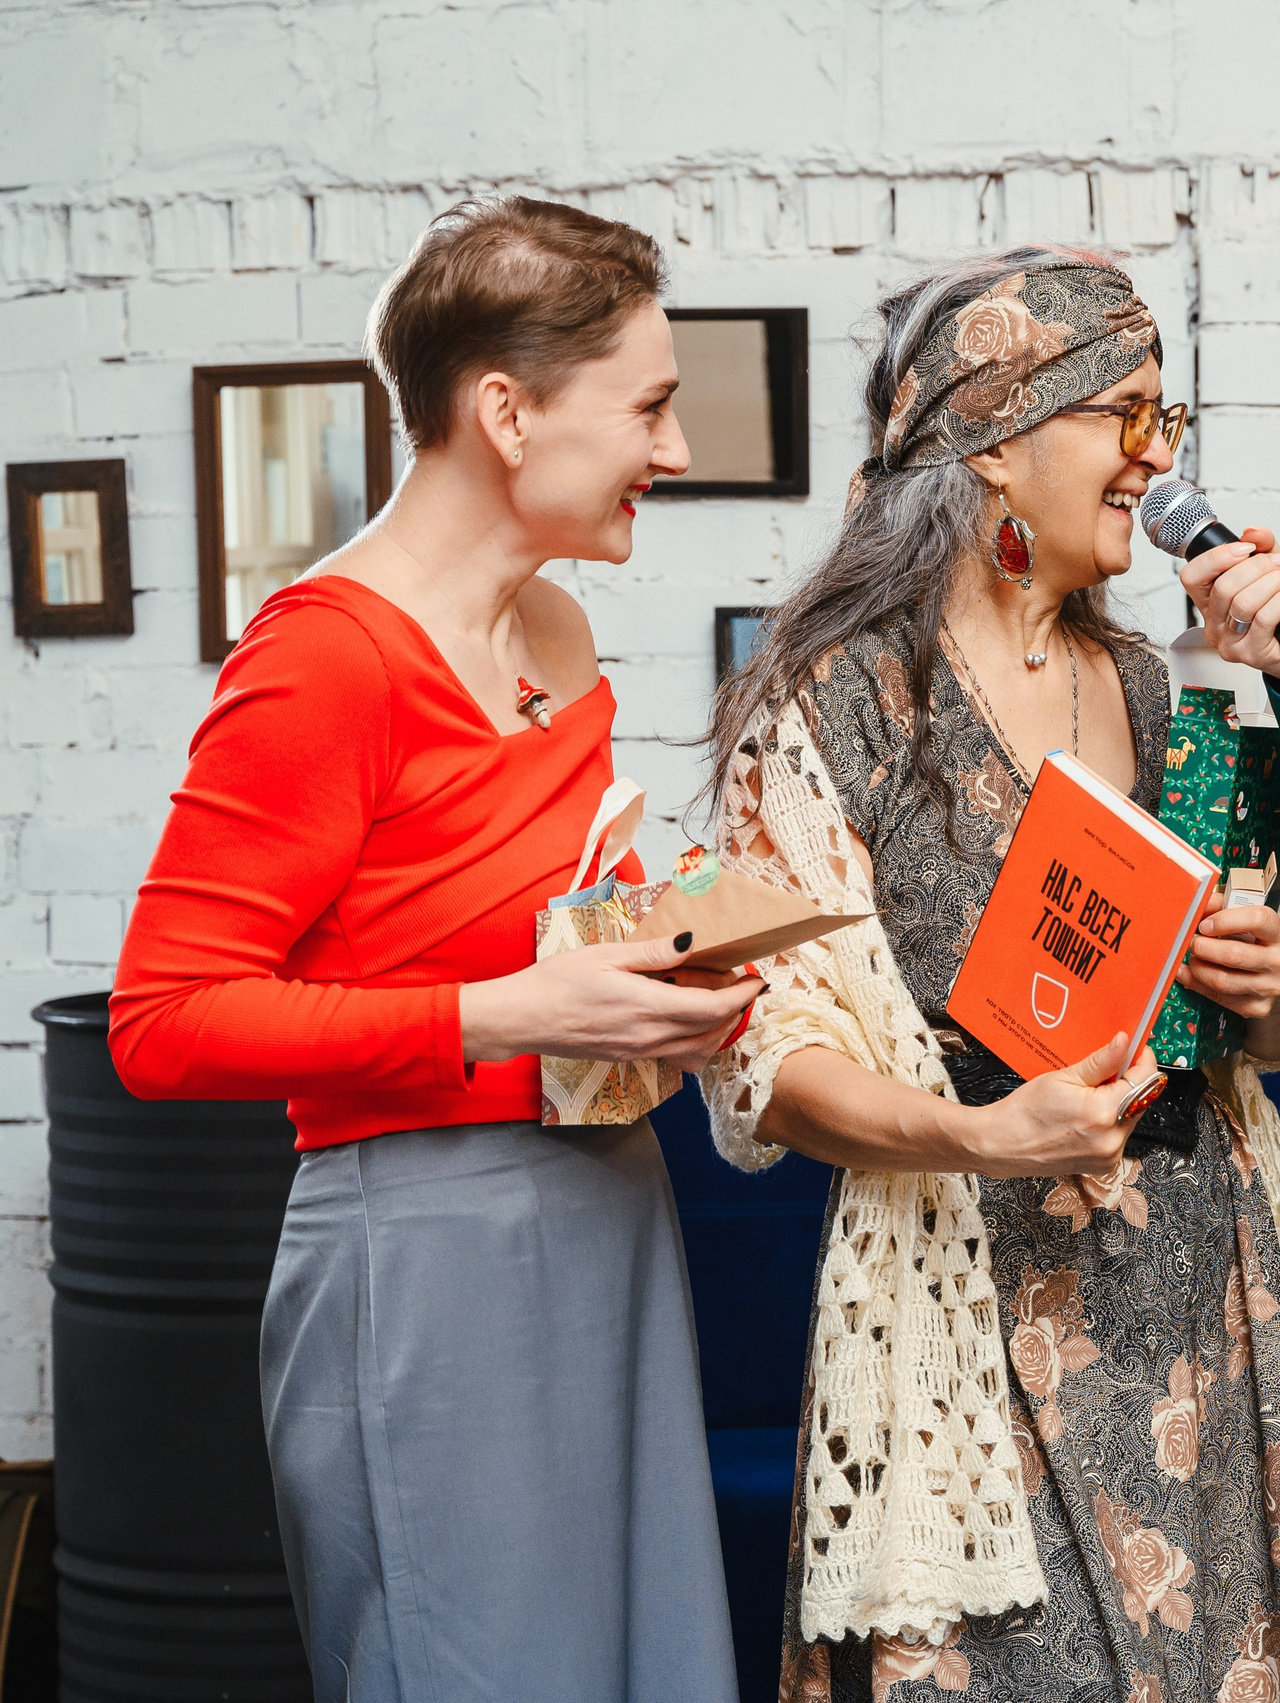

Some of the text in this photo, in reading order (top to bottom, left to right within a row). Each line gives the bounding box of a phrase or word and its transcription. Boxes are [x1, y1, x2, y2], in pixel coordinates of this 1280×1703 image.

[1084, 827, 1136, 871] виктор вилисов
[1040, 858, 1132, 954] НАС ВСЕХ
[1031, 906, 1106, 984] ТОШНИТ
[986, 998, 997, 1009] как
[997, 1007, 1017, 1025] театр
[1016, 1023, 1032, 1038] стал
[997, 1017, 1008, 1027] мы
[1007, 1025, 1026, 1043] этого
[1025, 1041, 1034, 1050] не
